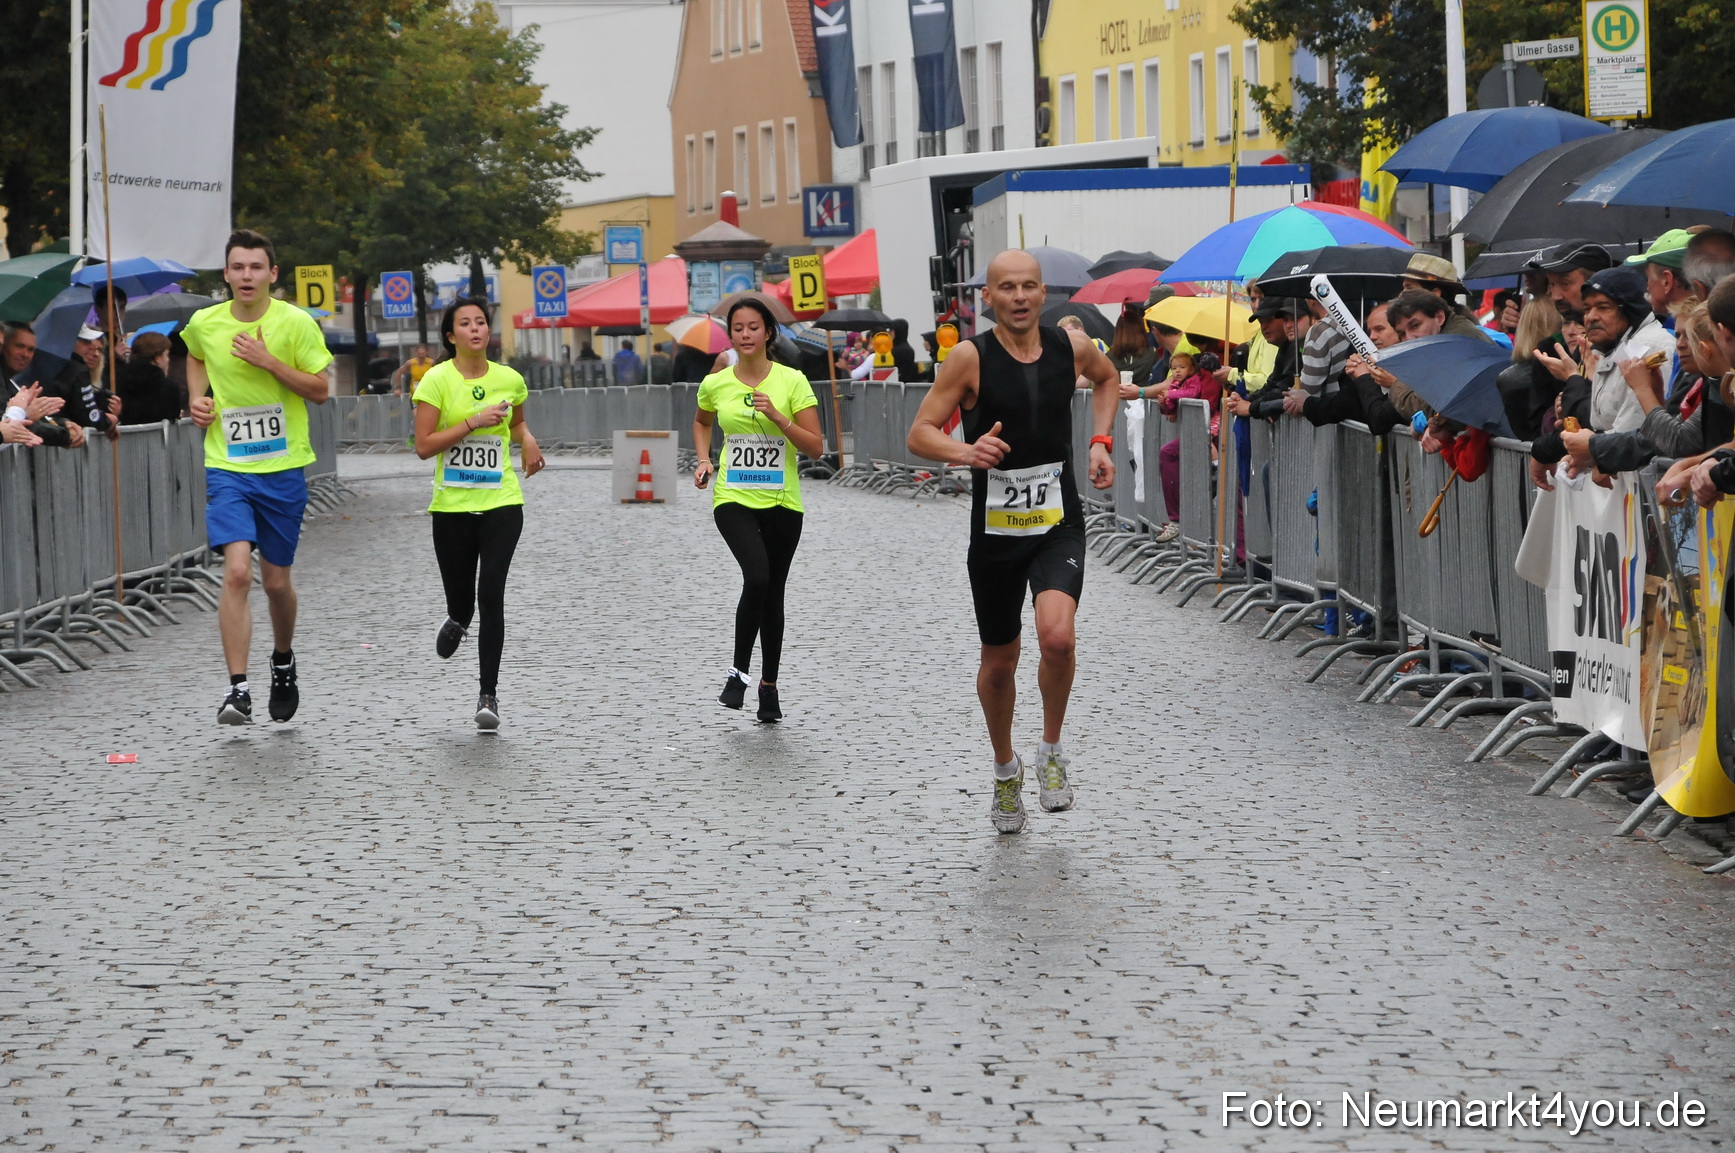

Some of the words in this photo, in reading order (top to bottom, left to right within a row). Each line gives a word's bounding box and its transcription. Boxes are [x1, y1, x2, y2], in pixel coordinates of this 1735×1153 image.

[1605, 15, 1627, 41] H
[1100, 19, 1131, 56] HOTEL
[1138, 16, 1171, 45] Lehmeier
[1517, 45, 1544, 57] Ulmer
[1547, 42, 1575, 54] Gasse
[1597, 56, 1637, 65] Marktplatz
[93, 171, 162, 188] stdtwerke
[793, 258, 820, 269] Block
[300, 268, 328, 278] Block
[799, 272, 818, 298] D
[307, 282, 325, 308] D
[386, 304, 412, 314] TAXI
[537, 301, 565, 313] TAXI
[229, 416, 281, 441] 2119
[243, 445, 271, 453] Tobias
[449, 446, 498, 468] 2030
[732, 446, 780, 468] 2032
[459, 472, 487, 481] Nadine
[738, 472, 771, 481] Vanessa
[989, 473, 1014, 484] PARTL
[1016, 471, 1051, 484] Neumarkt
[1006, 515, 1044, 526] Thomas
